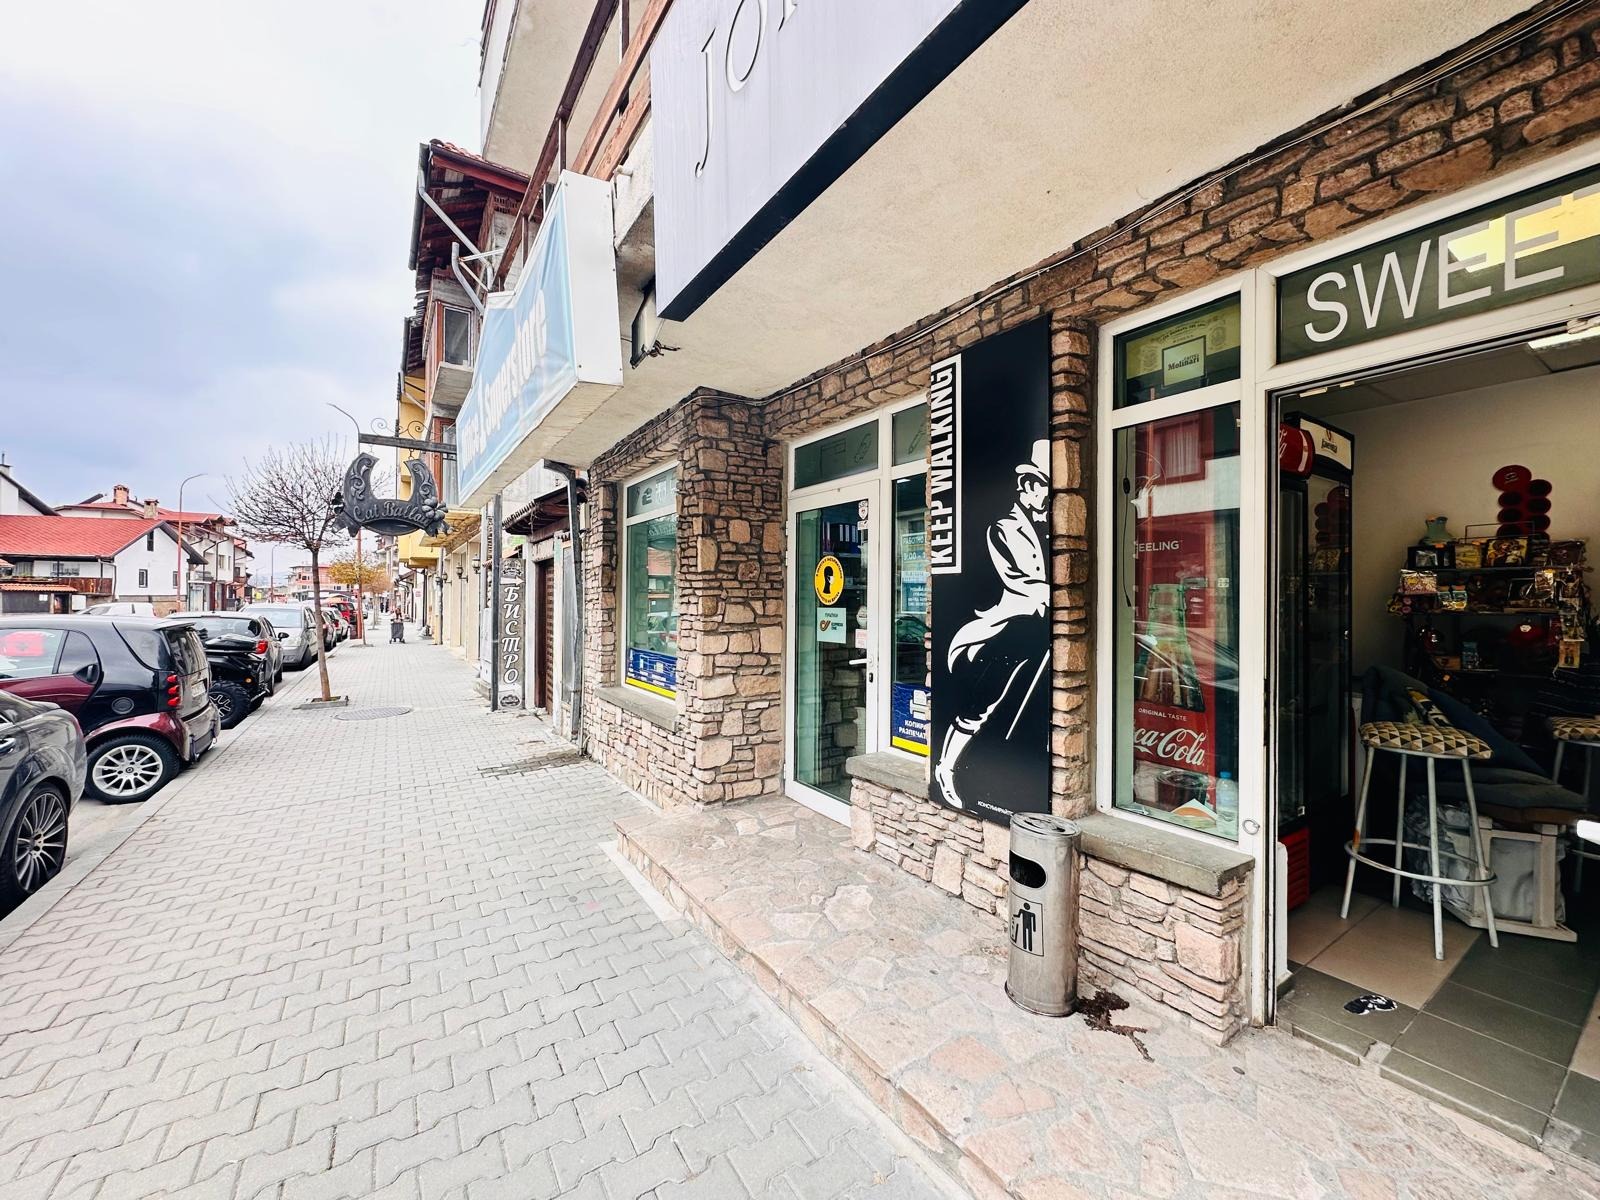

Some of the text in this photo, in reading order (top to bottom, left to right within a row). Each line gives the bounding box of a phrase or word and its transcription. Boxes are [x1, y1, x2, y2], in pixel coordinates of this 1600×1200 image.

[694, 0, 798, 178] JO
[1304, 182, 1600, 343] SWEE
[1167, 357, 1200, 371] Molinari
[931, 367, 953, 563] KEEP WALKING
[353, 504, 380, 522] Cat
[502, 586, 521, 684] БИСТРО
[904, 719, 925, 730] КОПИР
[1138, 707, 1188, 722] ORIGINAL TASTE
[898, 726, 926, 739] РАЗПЕЧАТ
[1134, 728, 1207, 766] ca-Cola
